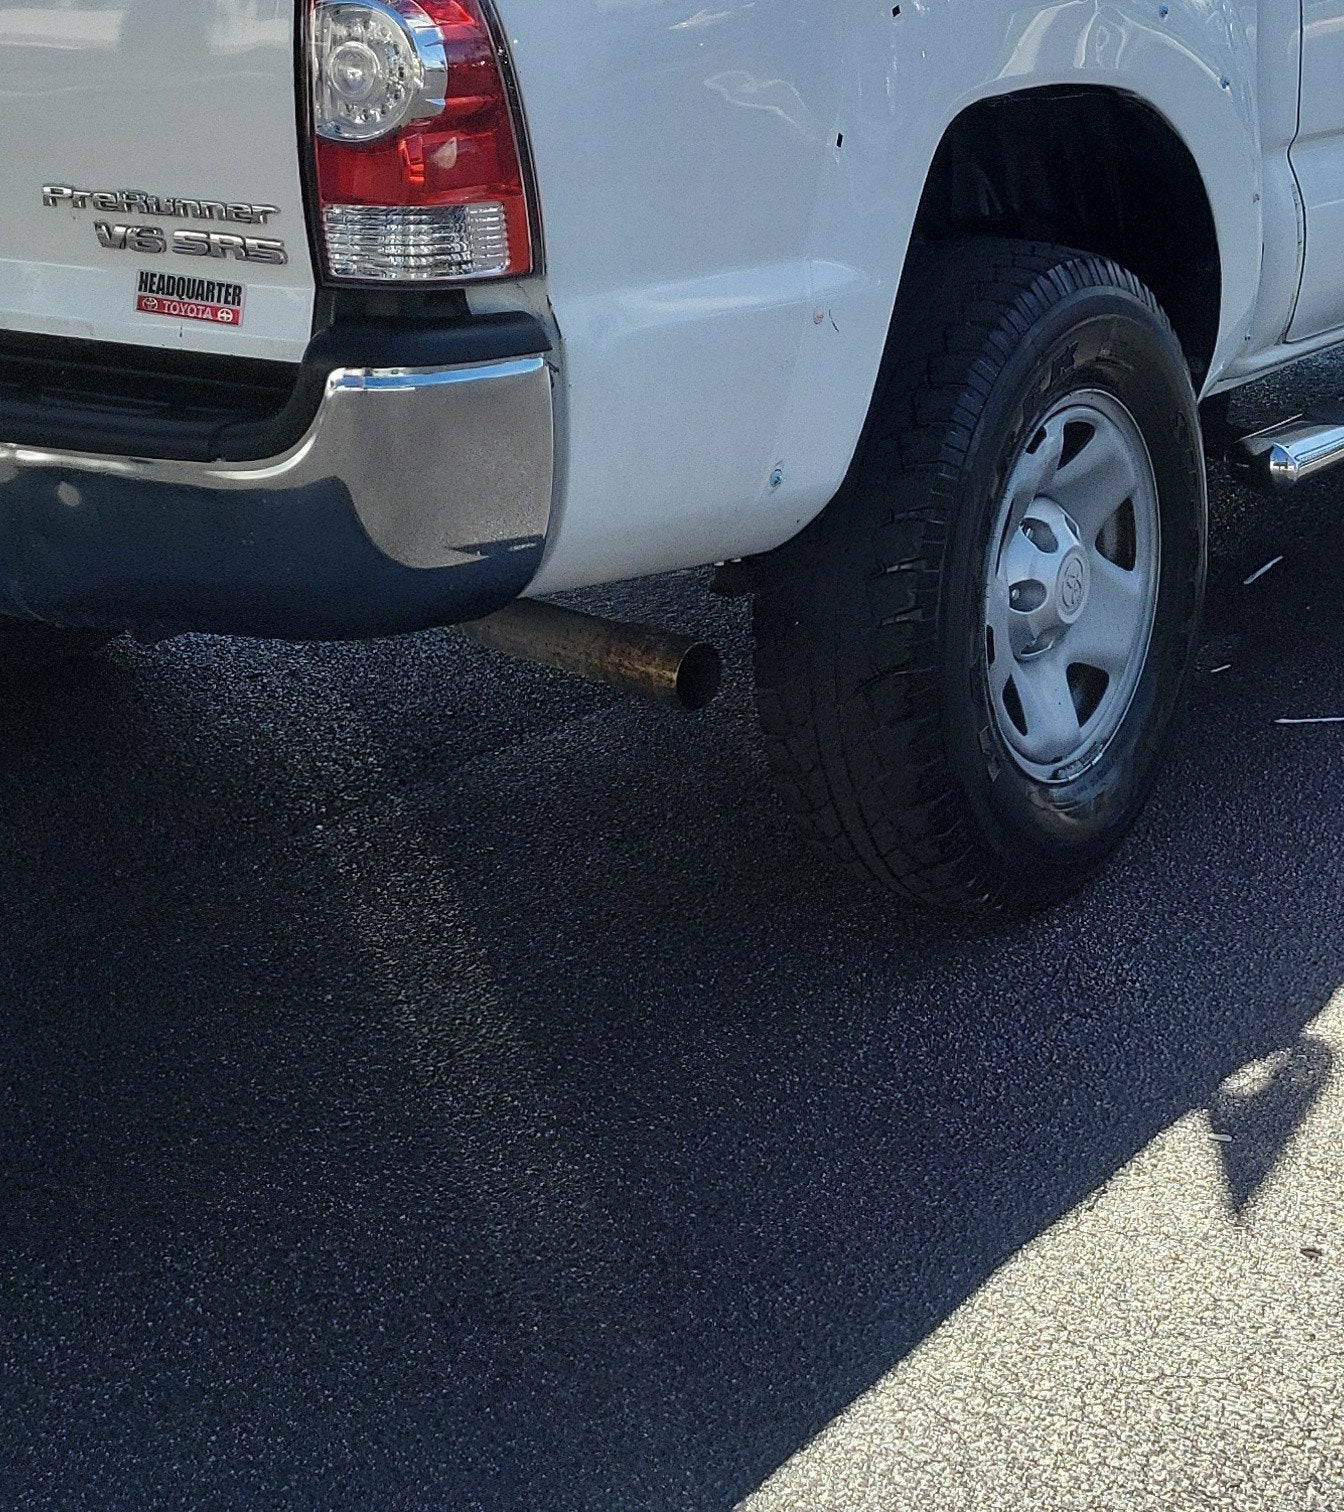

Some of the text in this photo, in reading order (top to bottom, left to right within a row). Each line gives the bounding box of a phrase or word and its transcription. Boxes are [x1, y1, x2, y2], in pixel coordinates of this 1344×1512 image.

[42, 184, 281, 224] PreRunner
[93, 219, 289, 265] V6 SR5
[138, 271, 243, 307] HEADQUARTER
[162, 300, 213, 322] TOYOTA
